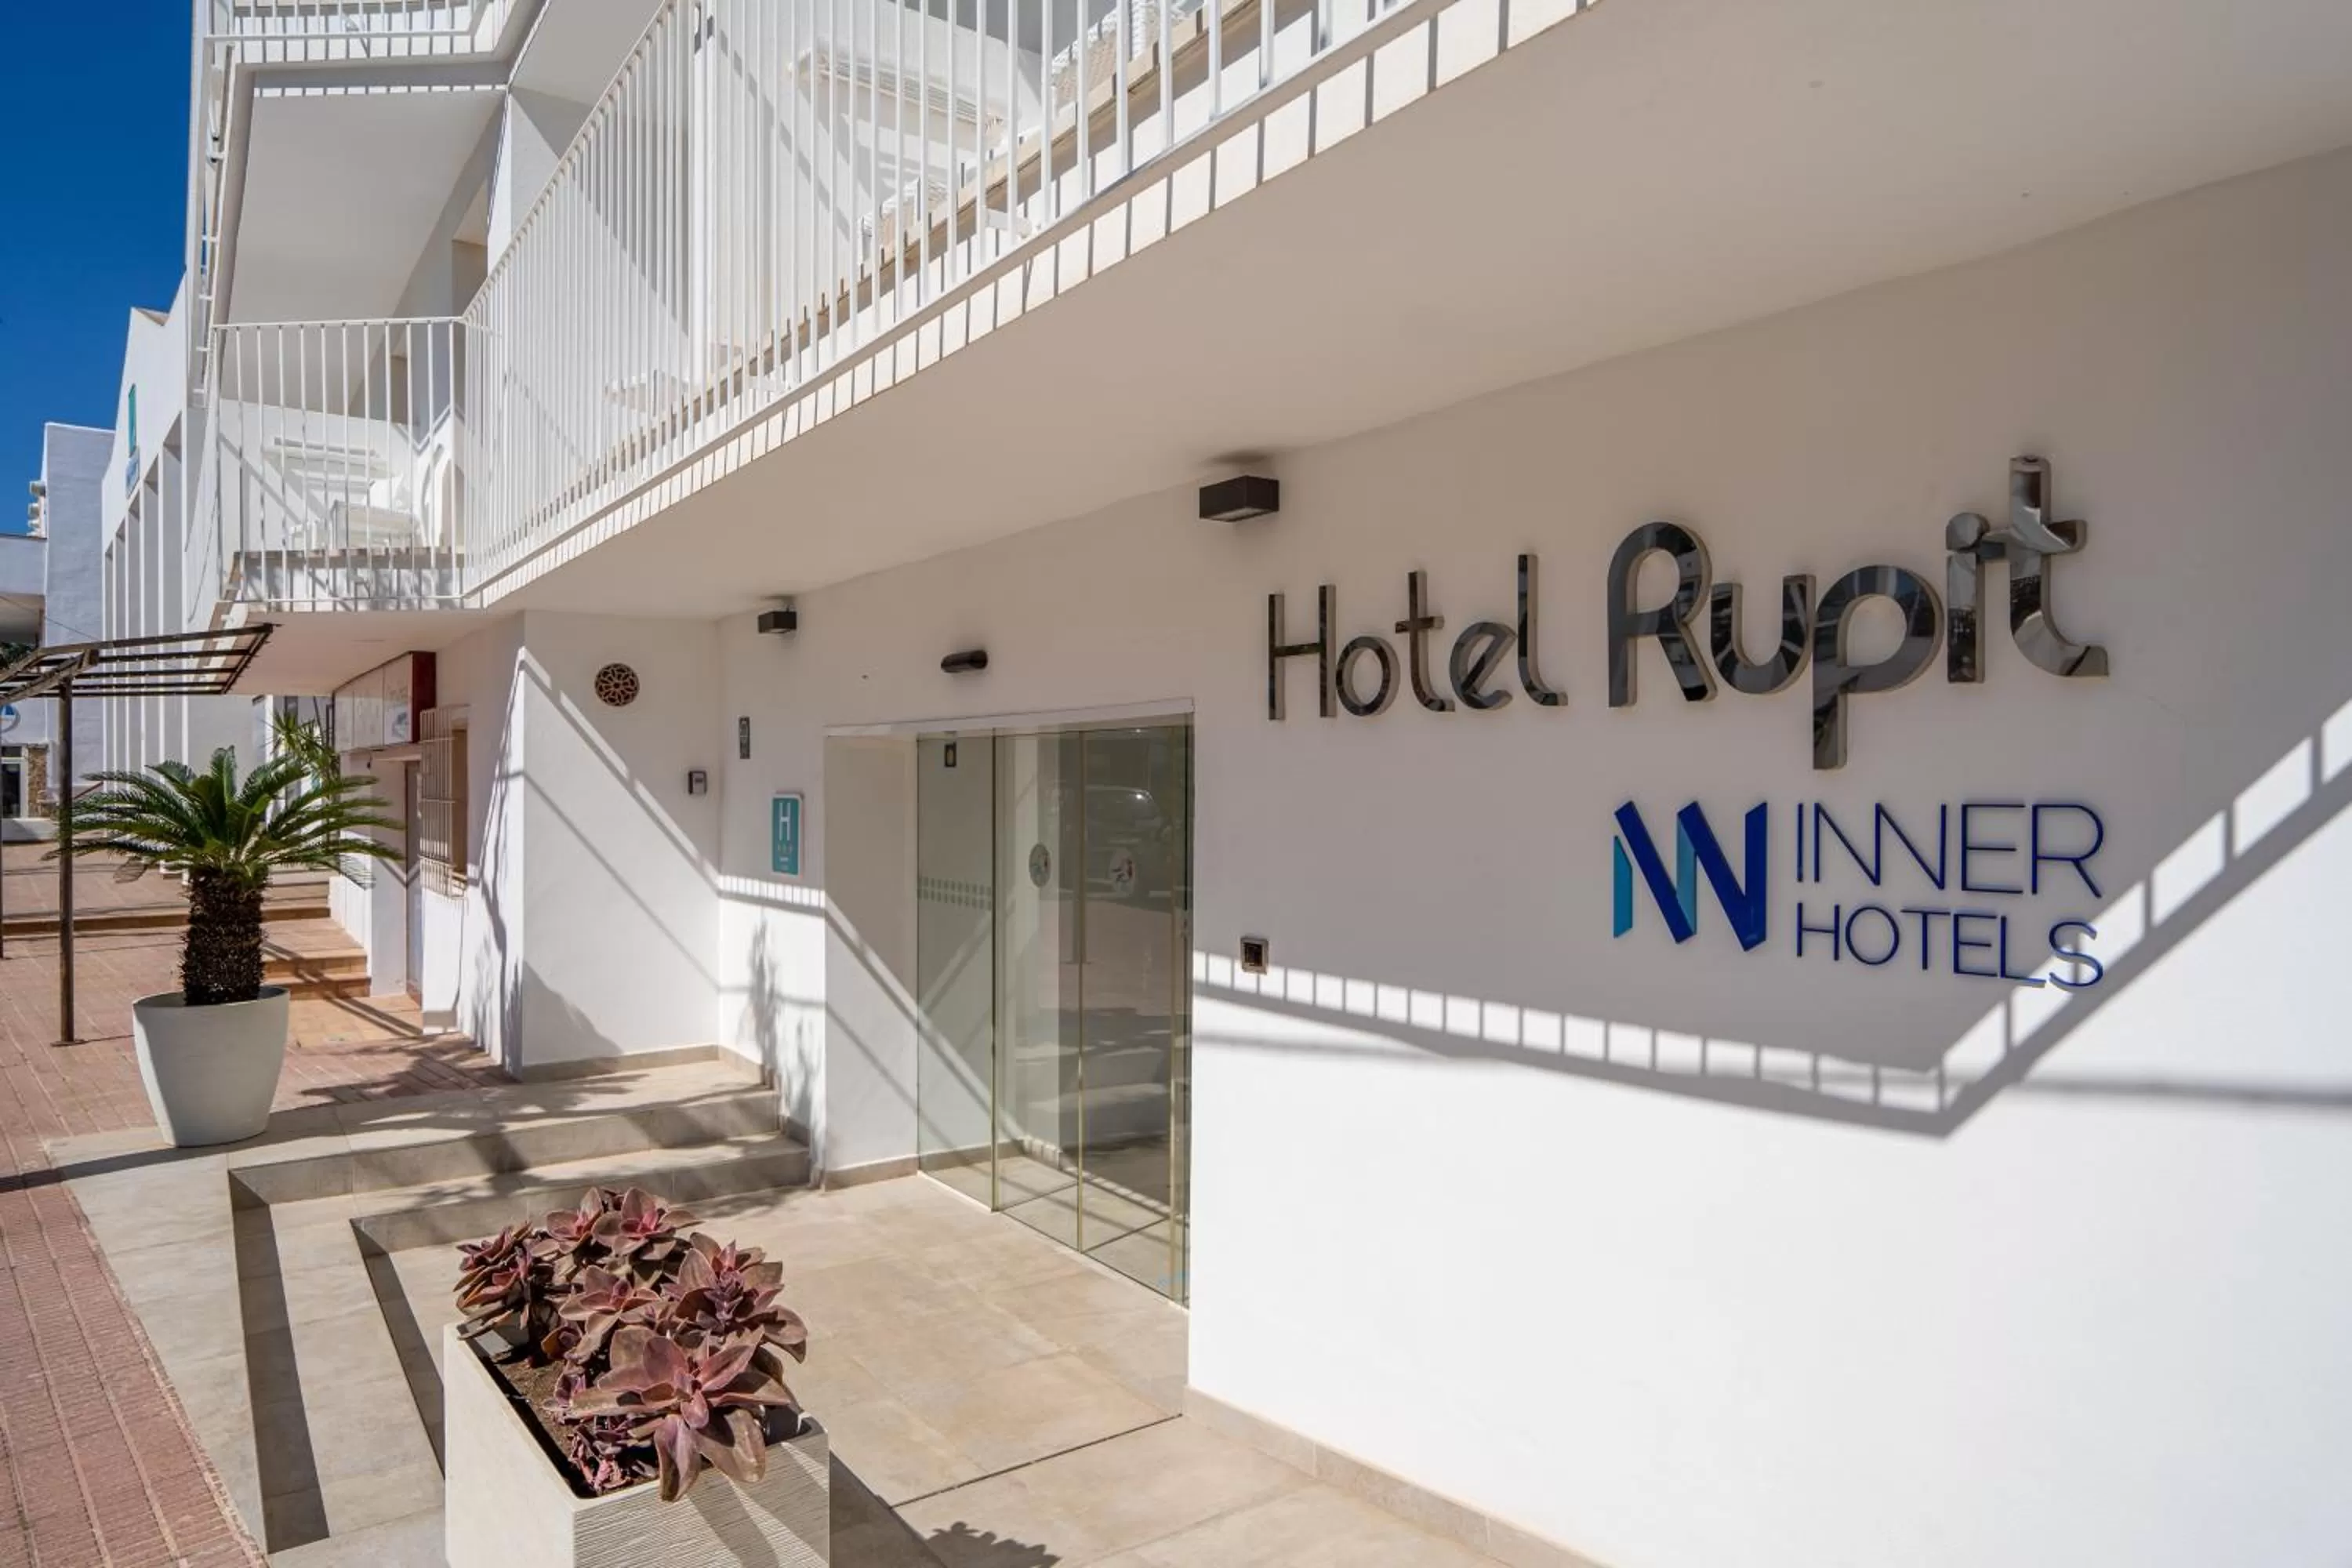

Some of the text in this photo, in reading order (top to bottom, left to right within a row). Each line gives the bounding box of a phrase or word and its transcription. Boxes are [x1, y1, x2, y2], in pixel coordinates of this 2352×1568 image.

[1268, 455, 2109, 770] Hotel Rupit
[779, 802, 790, 841] H
[1797, 802, 2103, 898] INNER
[1797, 902, 2104, 988] HOTELS
